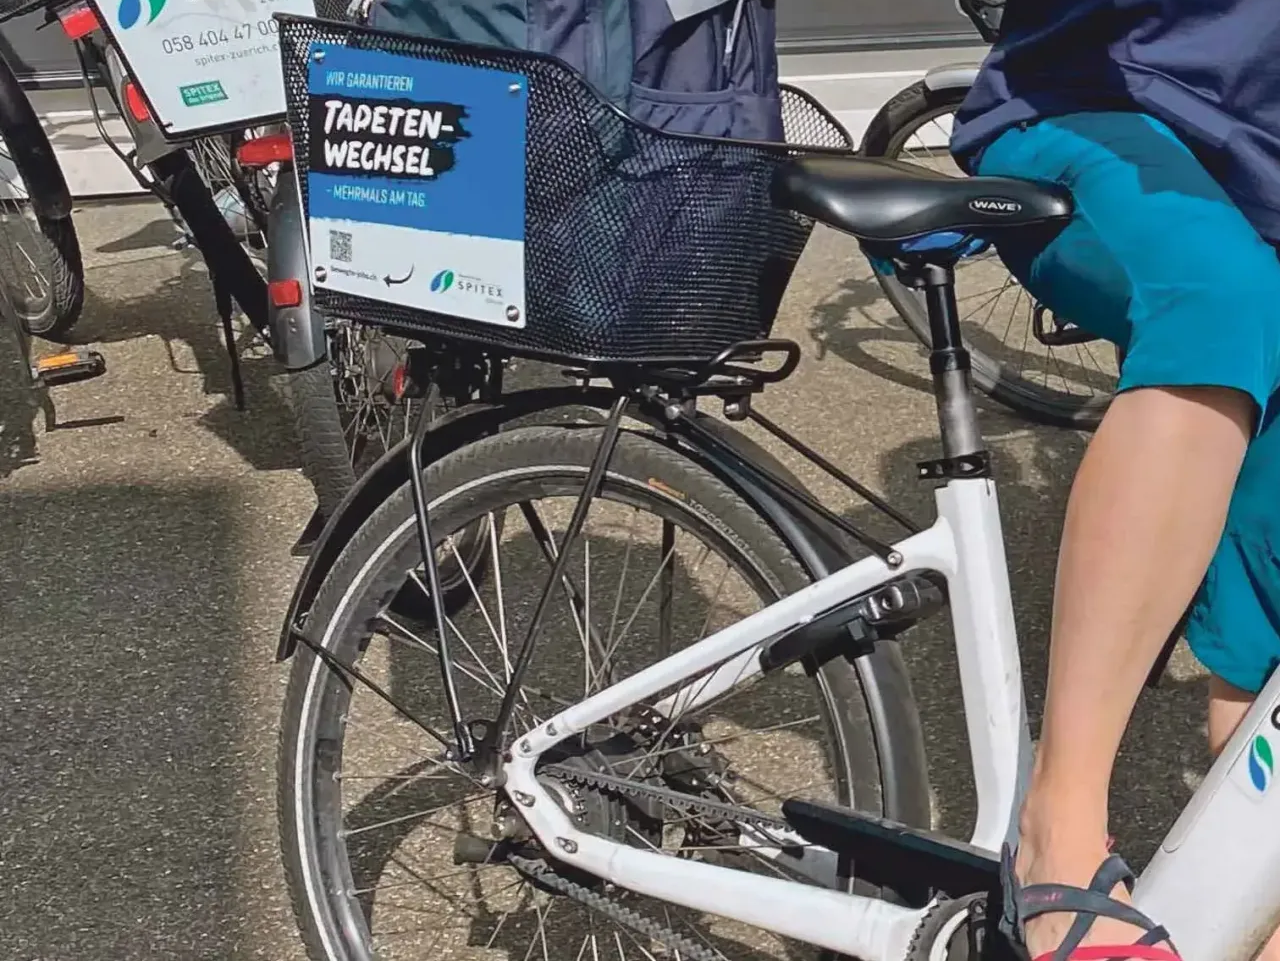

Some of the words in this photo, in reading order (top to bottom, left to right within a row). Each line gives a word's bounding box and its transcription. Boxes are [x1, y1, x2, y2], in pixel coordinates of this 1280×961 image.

[162, 34, 194, 55] 058
[199, 28, 229, 48] 404
[234, 23, 252, 40] 47
[257, 18, 279, 36] 00
[194, 43, 279, 66] spitex-zuerich.c
[326, 70, 345, 87] WIR
[346, 72, 414, 92] GARANTIEREN
[324, 99, 454, 140] TAPETEN-
[324, 138, 435, 176] WECHSEL
[333, 184, 388, 204] MEHRMALS
[389, 189, 406, 206] AM
[973, 199, 1017, 213] WAVE
[457, 280, 503, 298] SPITEX
